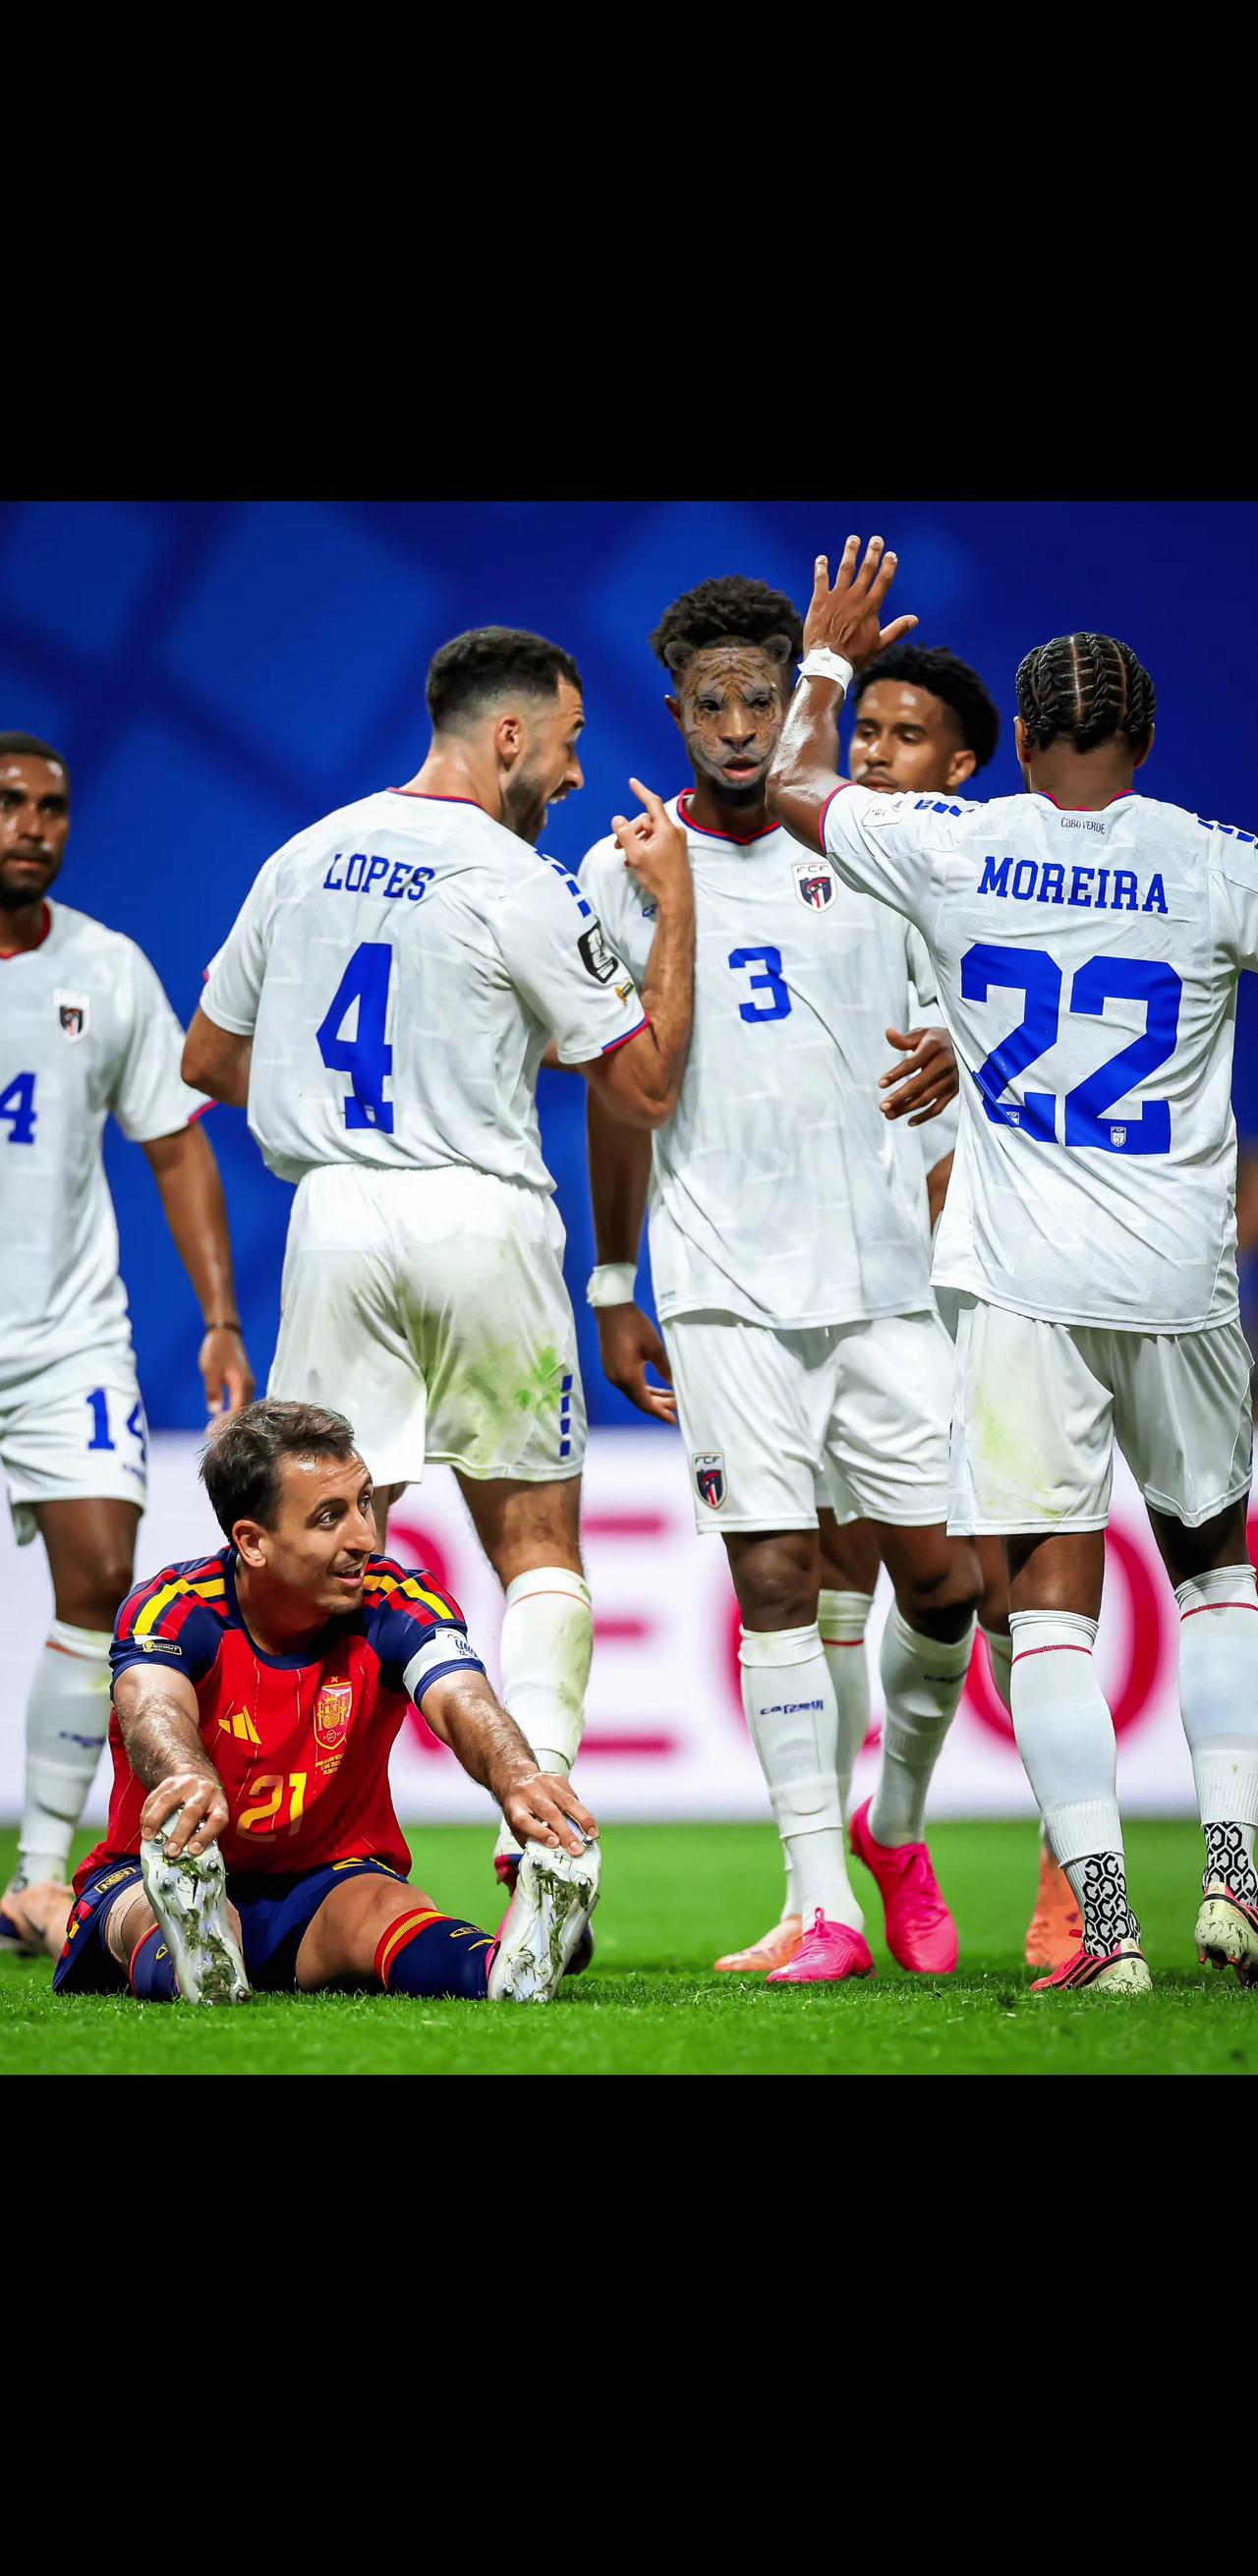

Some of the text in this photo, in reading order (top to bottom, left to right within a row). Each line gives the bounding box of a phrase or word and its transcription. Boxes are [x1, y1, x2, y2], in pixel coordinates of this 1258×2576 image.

[322, 853, 435, 901] LOPES
[977, 856, 1169, 914] MOREIRA
[728, 945, 792, 1023] 3
[314, 942, 394, 1134] 4
[960, 943, 1183, 1155] 22
[695, 1456, 721, 1464] FCF
[236, 1772, 308, 1843] 21
